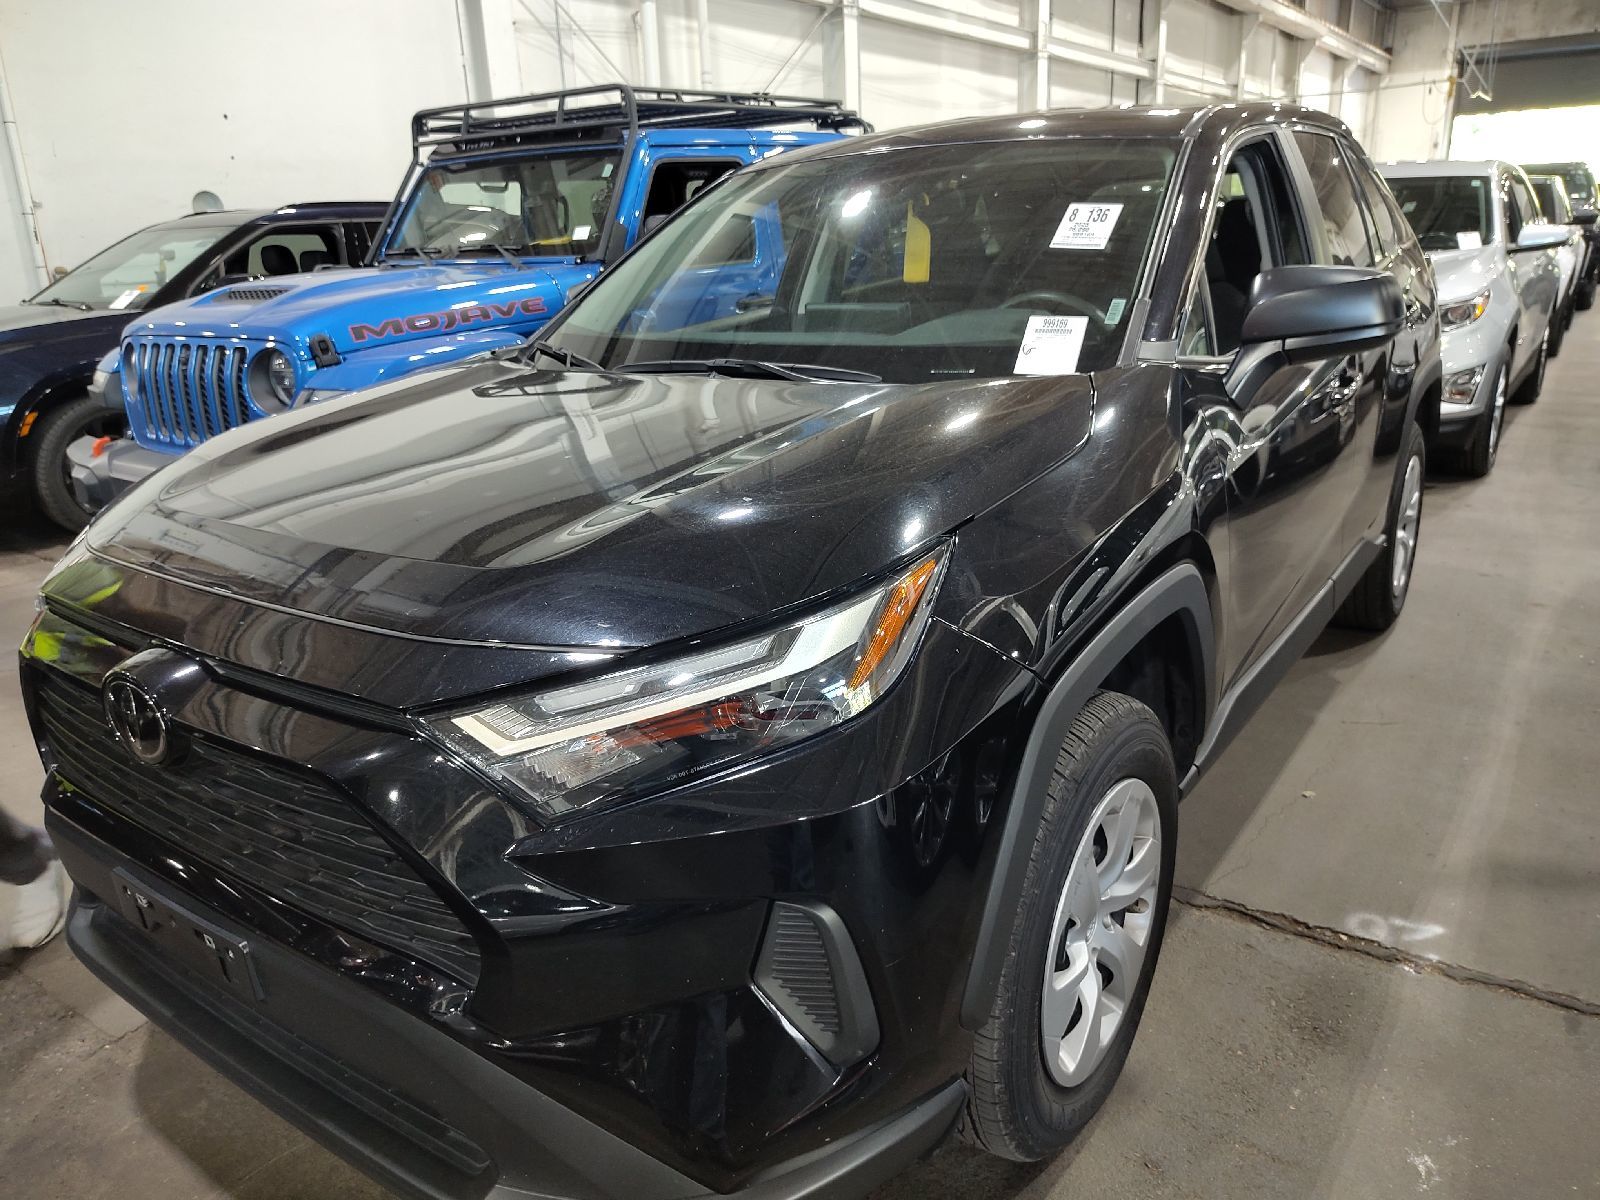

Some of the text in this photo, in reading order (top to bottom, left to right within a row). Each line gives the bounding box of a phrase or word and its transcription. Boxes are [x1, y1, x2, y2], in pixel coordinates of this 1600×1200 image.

[1069, 208, 1110, 223] 8 136
[349, 297, 547, 342] MOJAVE
